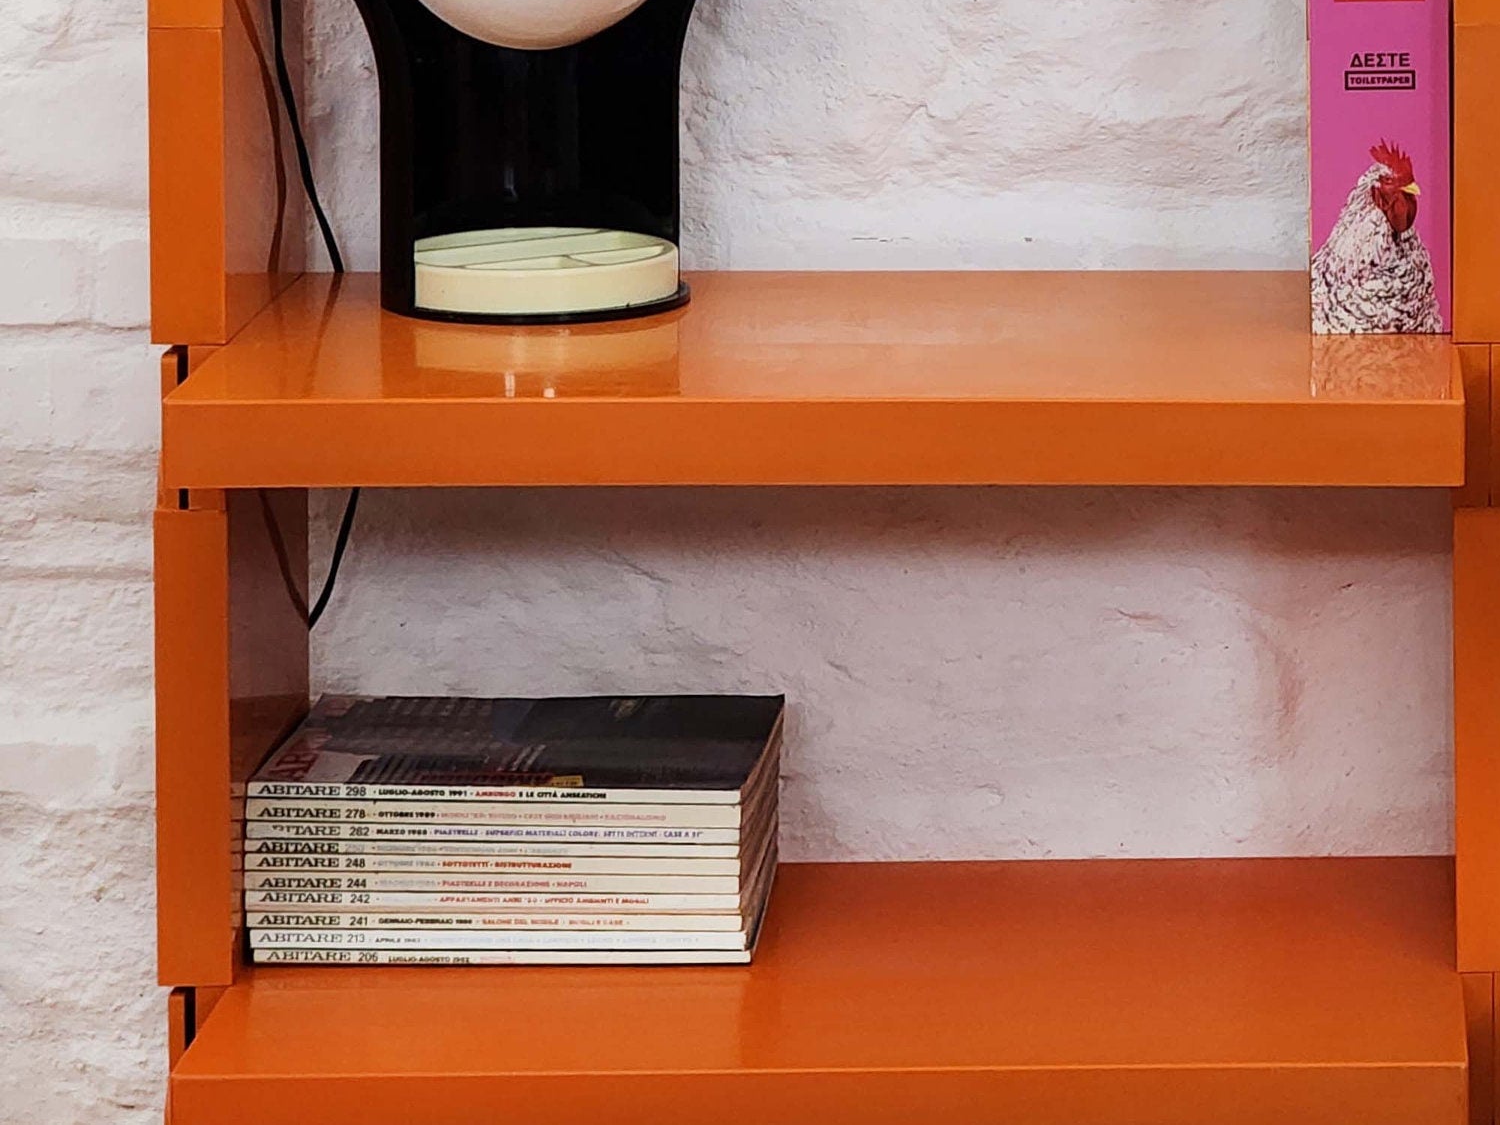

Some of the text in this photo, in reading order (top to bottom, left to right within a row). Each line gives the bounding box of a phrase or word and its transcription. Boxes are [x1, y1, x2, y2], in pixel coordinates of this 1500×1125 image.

[1350, 53, 1410, 67] ΔΕΣΤΕ
[258, 785, 341, 796] ABITARE
[345, 786, 366, 797] 298
[257, 807, 341, 818] ABITARE
[345, 809, 366, 819] 278
[256, 841, 339, 853] ABITARE
[256, 857, 340, 868] ABITARE
[345, 858, 366, 868] 248
[259, 878, 342, 888] ABITARE
[347, 878, 366, 888] 244
[259, 893, 342, 903] ABITARE
[350, 894, 370, 904] 242
[258, 915, 340, 925] ABITARE
[350, 916, 368, 926] 241
[258, 933, 343, 943] ABITARE
[347, 934, 366, 944] 213
[266, 951, 351, 962] ABITARE
[358, 952, 379, 962] 206
